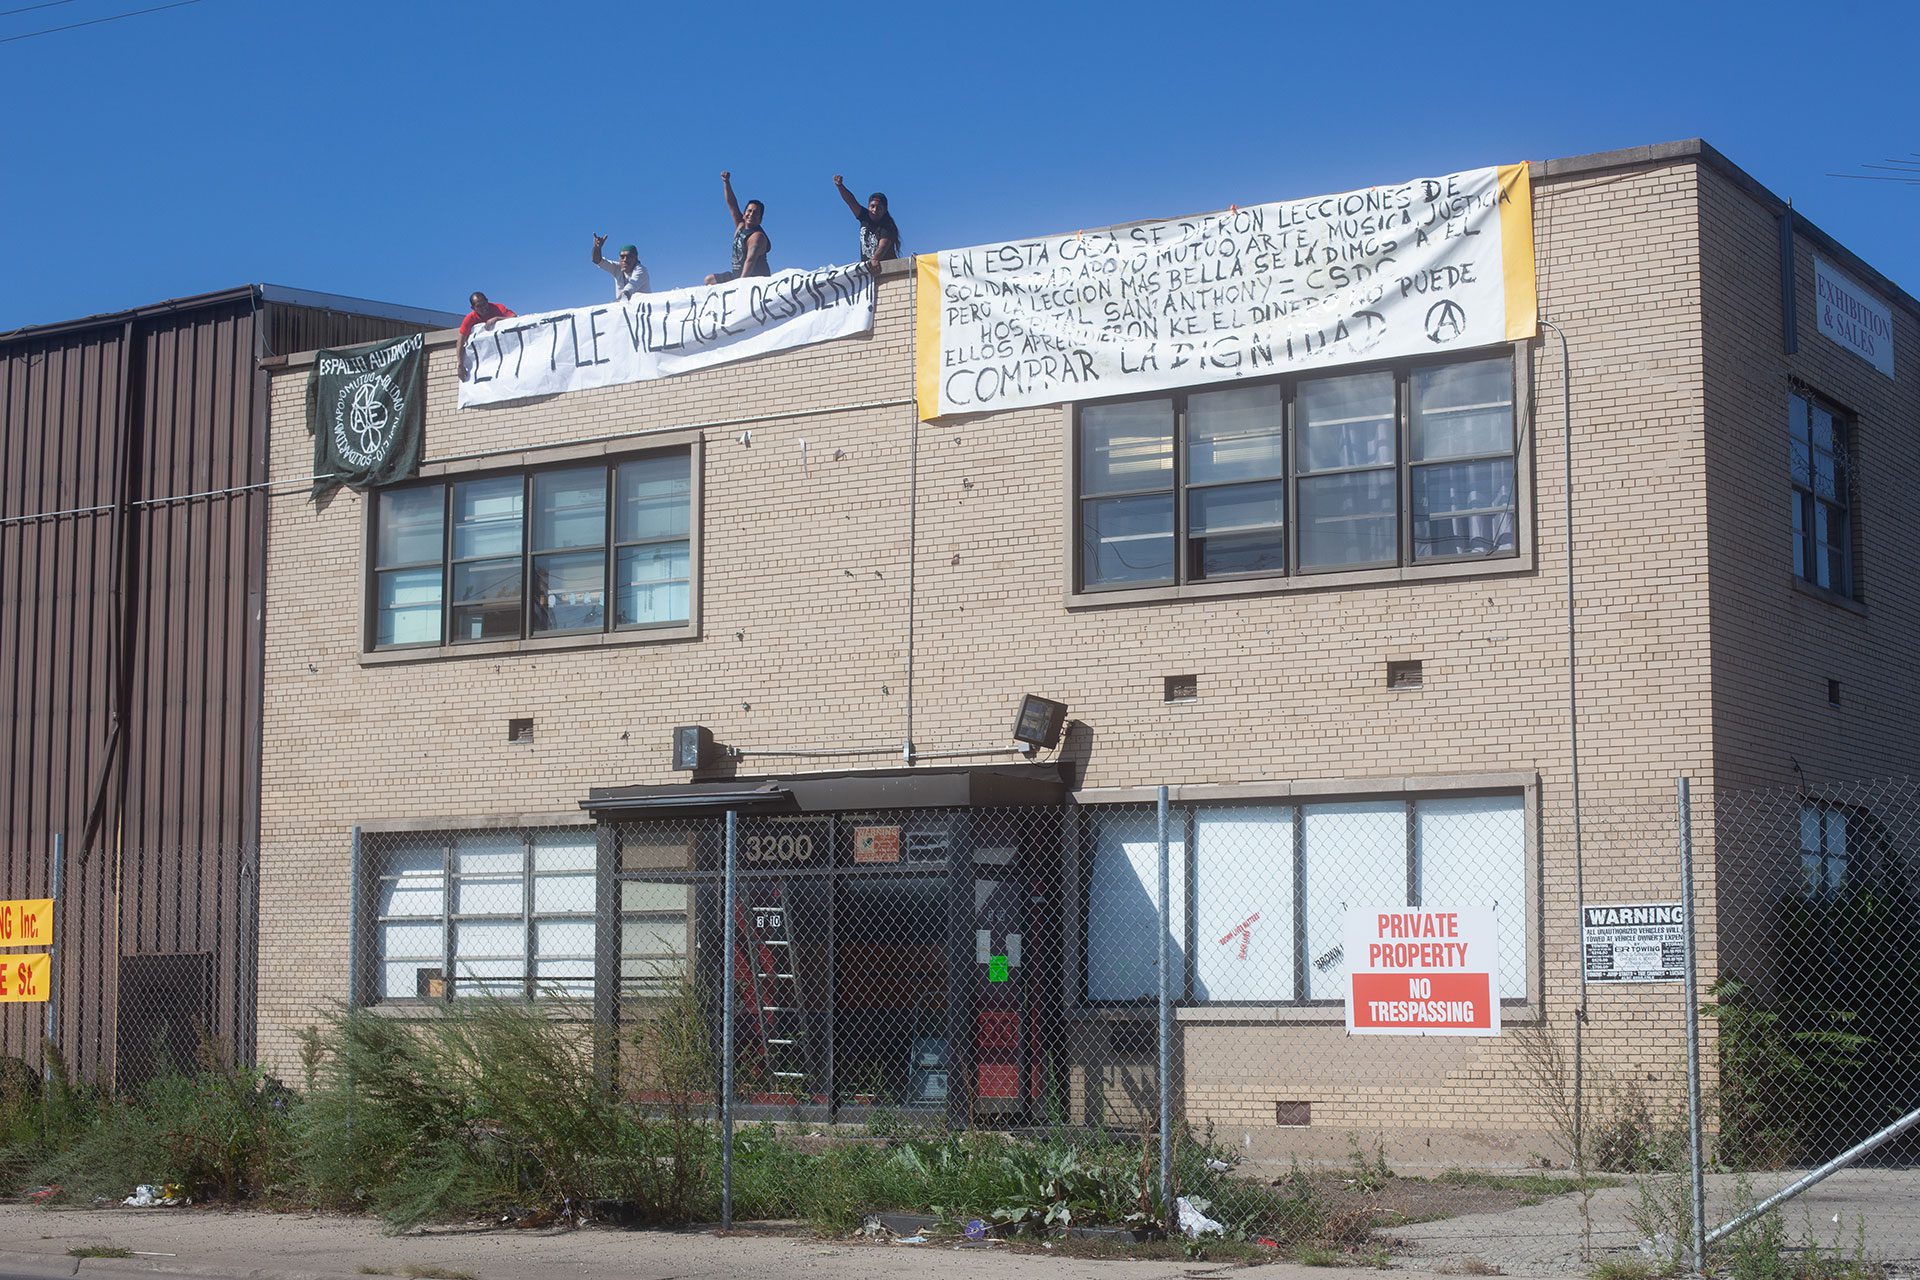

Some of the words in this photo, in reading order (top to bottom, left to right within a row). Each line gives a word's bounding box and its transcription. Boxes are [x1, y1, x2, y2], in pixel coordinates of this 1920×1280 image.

[950, 250, 974, 278] EN
[986, 242, 1049, 273] ESTA
[1130, 226, 1166, 249] SE
[1279, 187, 1411, 229] LECCIONES
[1421, 175, 1460, 203] DE
[1079, 252, 1148, 280] APOYO
[1424, 186, 1511, 226] JUSTICIA
[946, 301, 991, 326] PERO
[1031, 278, 1112, 312] LECCION
[1120, 271, 1160, 298] MAS
[1166, 259, 1243, 292] BELLA
[1254, 252, 1286, 275] SE
[1322, 238, 1398, 265] DIMOS
[1445, 217, 1480, 240] EL
[1163, 275, 1272, 316] ANTHONY
[1817, 273, 1890, 342] EXHIBITION
[945, 340, 1013, 367] ELLOS
[1170, 316, 1206, 337] KE
[1212, 309, 1245, 330] EL
[1395, 261, 1477, 298] PUEDE
[1824, 304, 1833, 329] &
[1837, 313, 1874, 357] SALES
[471, 309, 610, 384] LITTLE
[623, 288, 745, 353] VILLAGE
[344, 372, 375, 394] MUTUO
[946, 349, 1100, 405] COMPRAR
[1121, 343, 1159, 373] LA
[746, 835, 812, 861] 3200
[20, 906, 38, 938] Inc.
[1378, 913, 1458, 938] PRIVATE
[1588, 907, 1683, 925] WARNING
[1369, 943, 1468, 967] PROPERTY
[18, 963, 36, 995] St.
[1409, 978, 1431, 999] NO
[1368, 1001, 1474, 1022] TRESPASSING
